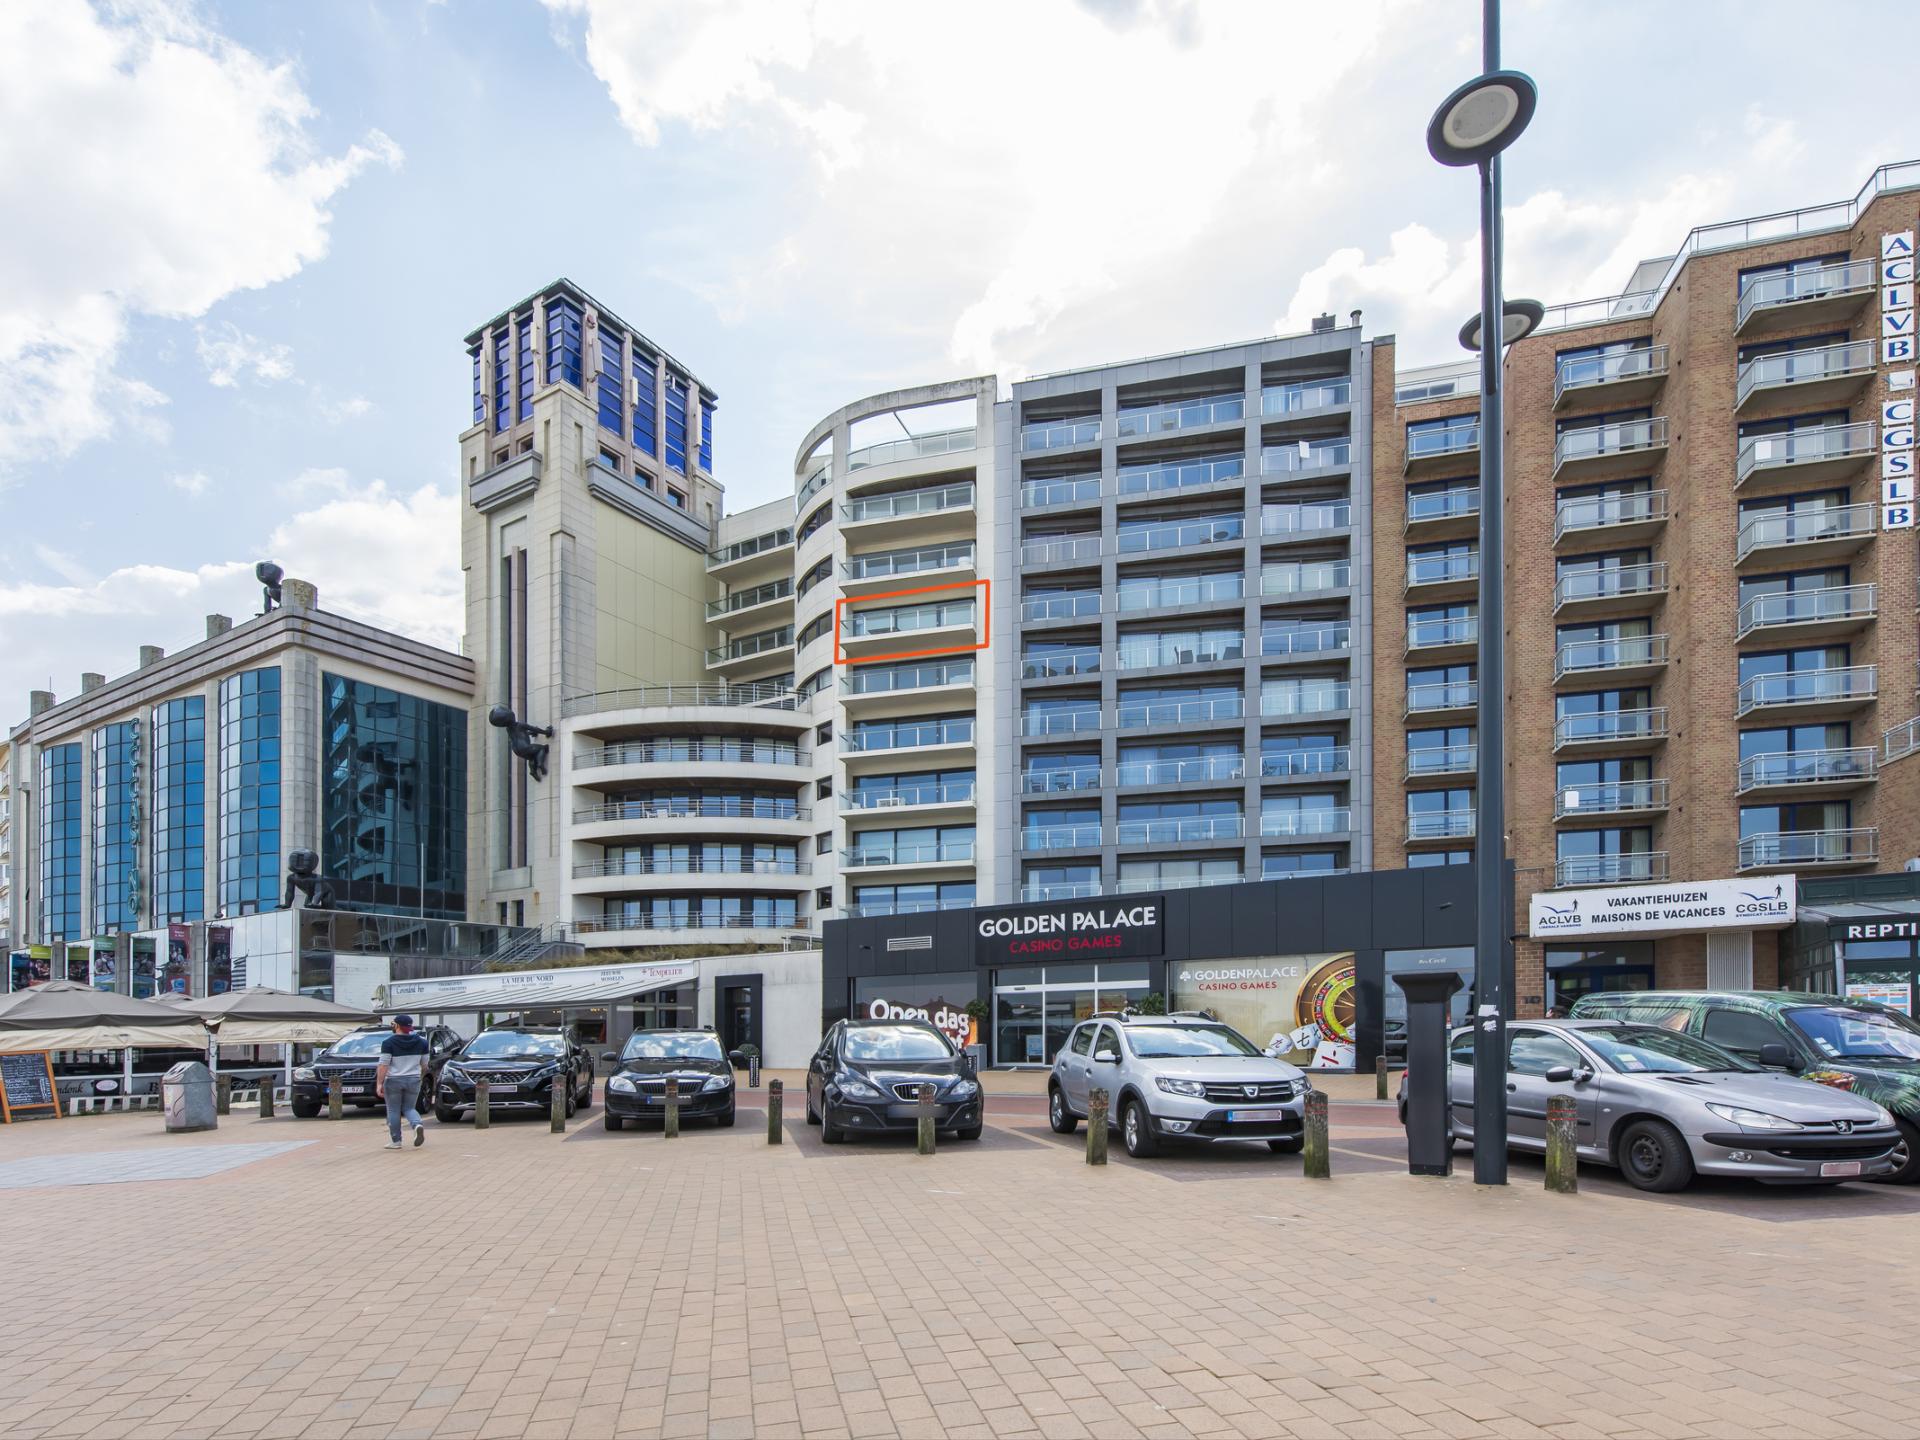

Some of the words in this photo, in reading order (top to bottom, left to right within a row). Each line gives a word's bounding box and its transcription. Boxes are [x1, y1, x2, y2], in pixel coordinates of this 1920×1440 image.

[1884, 236, 1911, 358] ACLVB
[1883, 403, 1913, 525] CGSLB
[1607, 891, 1708, 907] VAKANTIEHUIZEN
[1735, 901, 1788, 913] CGSLB
[979, 913, 1066, 937] GOLDEN
[1072, 906, 1157, 931] PALACE
[1538, 914, 1582, 925] ACLVB
[1591, 911, 1642, 923] MAISONS
[1645, 910, 1660, 920] DE
[1663, 906, 1726, 919] VACANCES
[1848, 922, 1917, 939] REPTI
[1009, 938, 1064, 954] CASINO
[1068, 935, 1122, 950] GAMES
[1198, 982, 1237, 991] CASINO
[1240, 981, 1278, 990] GAMES
[934, 1006, 970, 1036] dag
